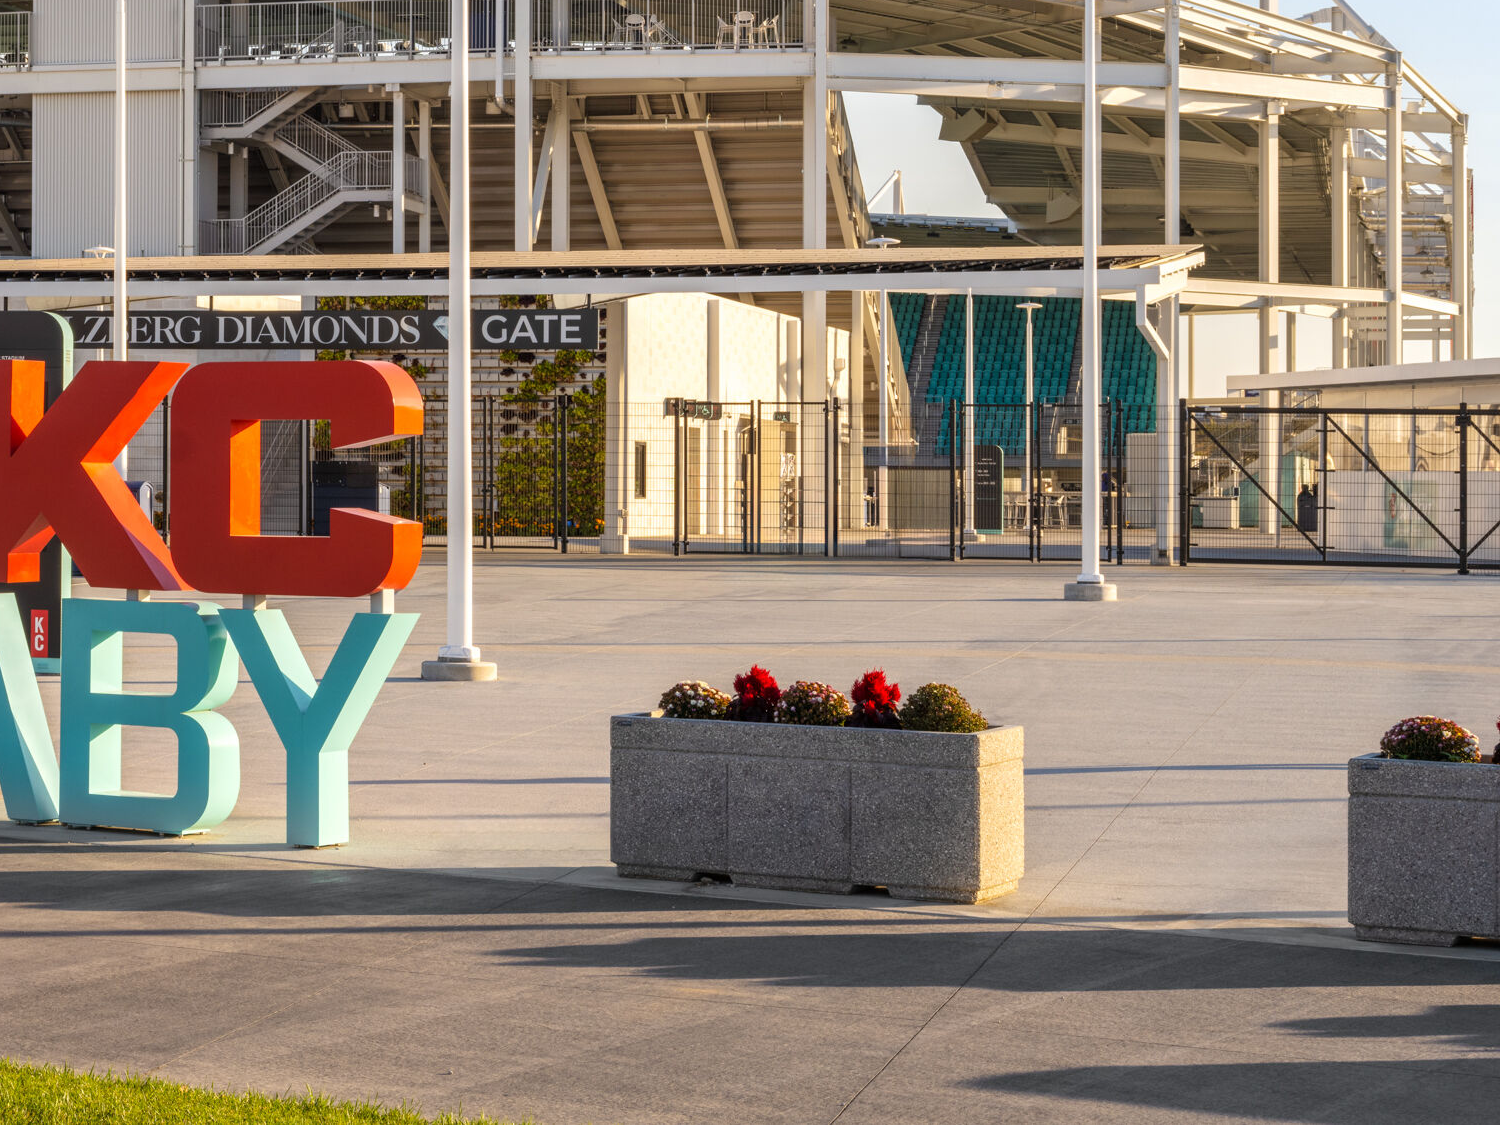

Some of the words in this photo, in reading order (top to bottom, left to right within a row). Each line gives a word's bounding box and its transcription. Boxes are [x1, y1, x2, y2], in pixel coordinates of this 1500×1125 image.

[215, 315, 421, 345] DIAMONDS
[481, 314, 583, 344] GATE
[34, 616, 45, 652] KC
